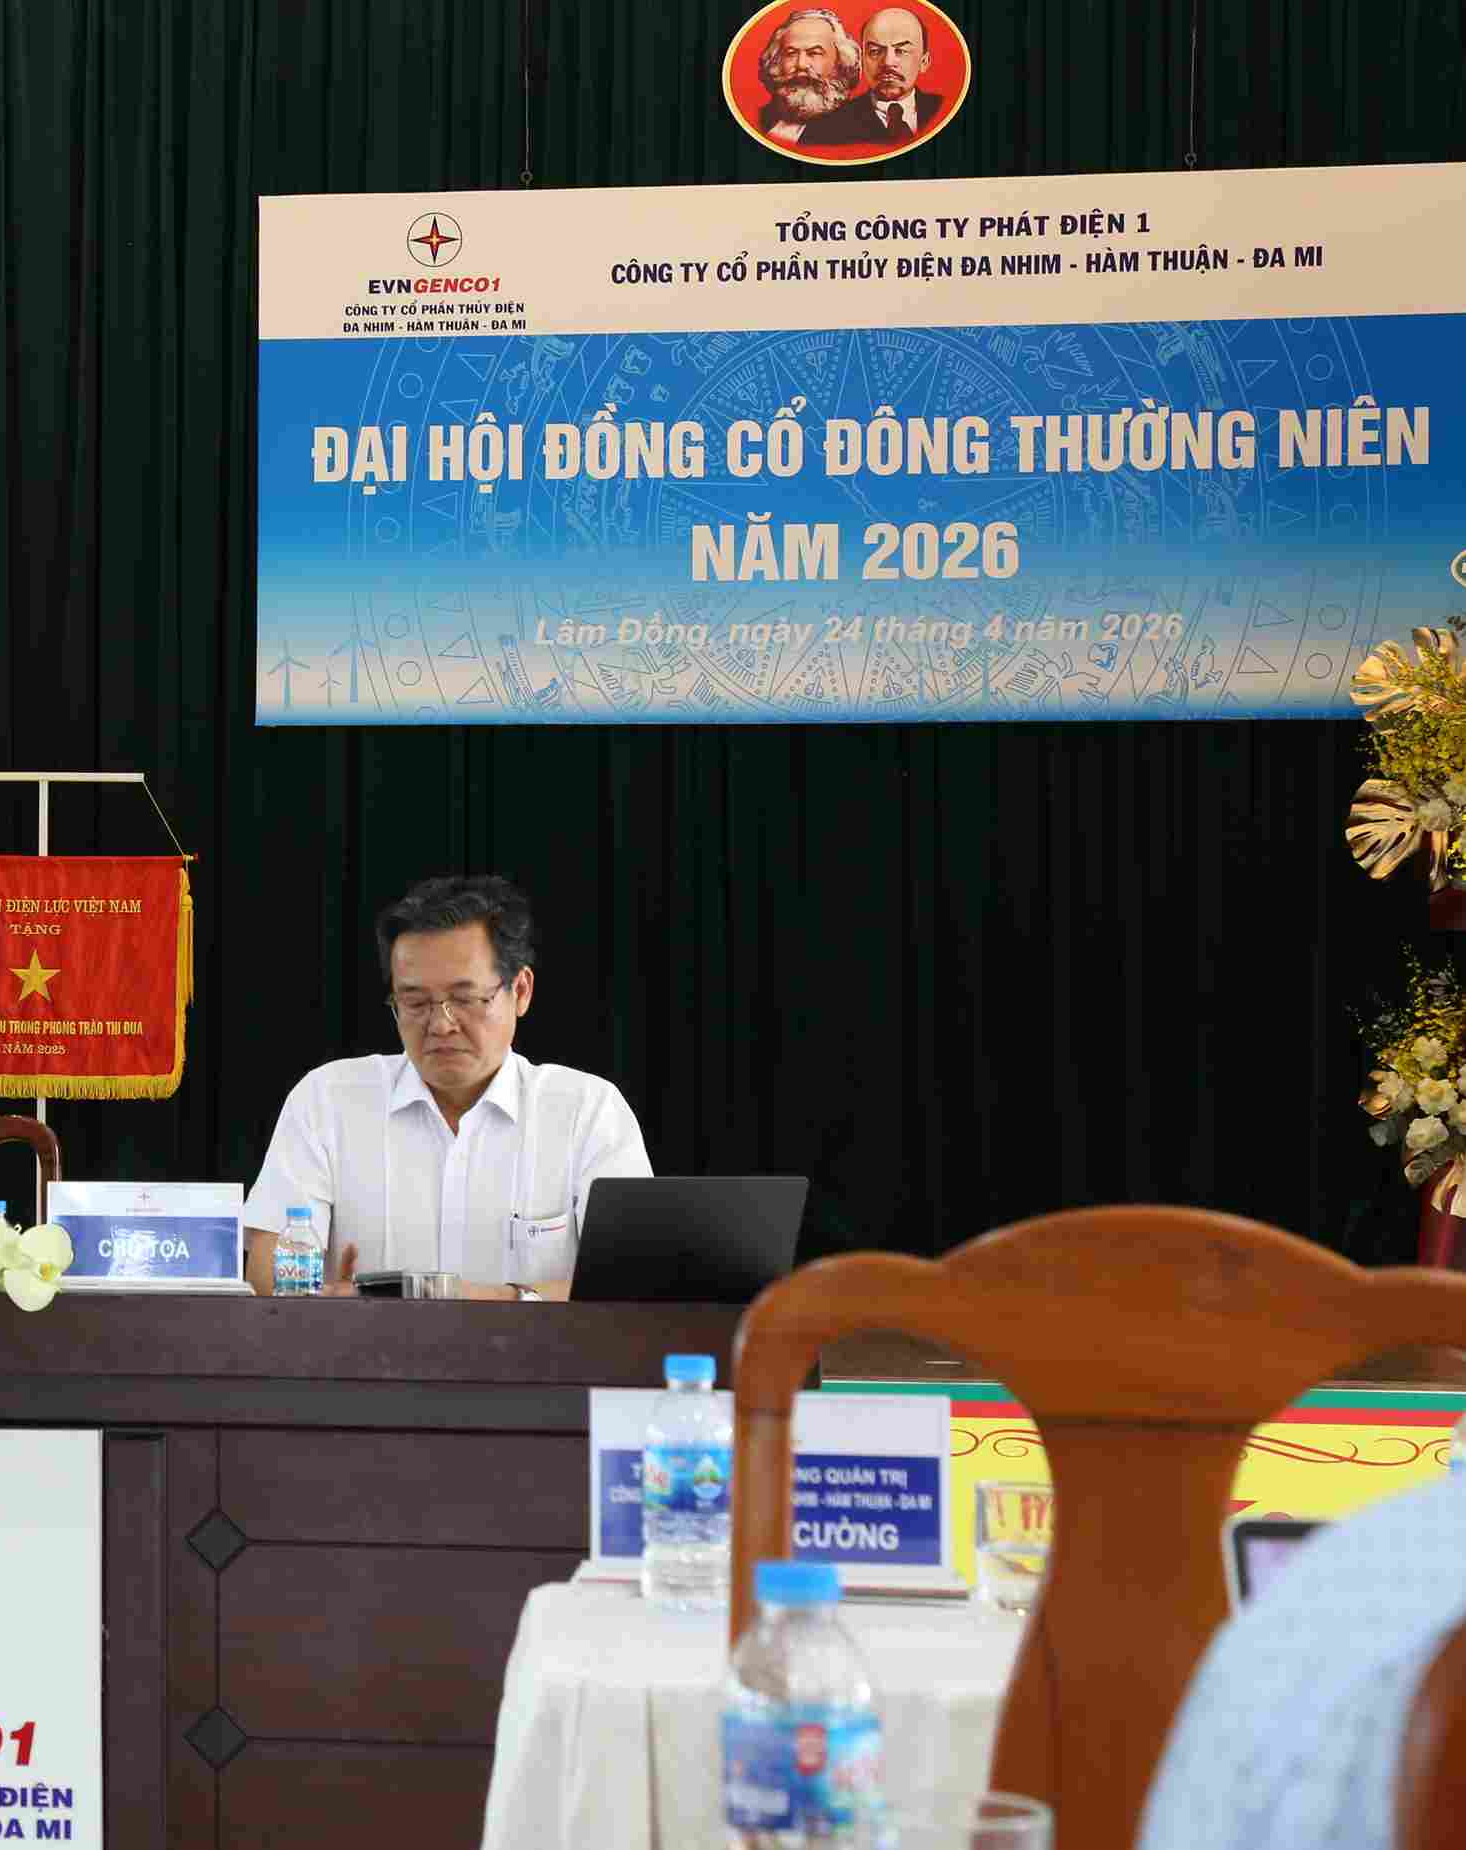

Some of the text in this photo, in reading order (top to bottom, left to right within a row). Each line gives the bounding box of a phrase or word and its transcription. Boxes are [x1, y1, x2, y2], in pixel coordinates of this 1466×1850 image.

[775, 208, 1150, 242] TỔNG CÔNG TY PHÁT ĐIỆN 1
[611, 244, 1323, 284] CÔNG TY CỔ PHẦN THỦY ĐIỆN ĐA NHIM HÀM THUẬN ĐA MI
[368, 277, 501, 294] EVNGENCO1
[345, 298, 524, 316] CÔNG TY CỔ PHẦN THỦY ĐIỆN
[343, 318, 526, 333] ĐA NHIM HÀM THUẬN ĐA MI
[312, 395, 1431, 495] ĐẠI HỘI ĐỒNG CỔ ĐÔNG THƯỜNG NIÊN
[691, 511, 1019, 581] NĂM 2026
[537, 618, 607, 642] Lâm
[730, 616, 814, 654] ngày
[823, 614, 864, 642] 24
[872, 614, 973, 649] tháng
[983, 611, 1007, 641] 4
[1014, 614, 1090, 641] năm
[1101, 611, 1185, 641] 2026
[6, 895, 40, 916] ĐIỆN
[44, 897, 70, 916] LỰC
[73, 895, 105, 917] VIỆT
[109, 899, 142, 913] NAM
[10, 922, 63, 936] TẶNG
[9, 1020, 42, 1035] TRONG
[43, 1020, 76, 1035] PHONG
[78, 1017, 103, 1036] TRÀO
[106, 1020, 121, 1035] THI
[123, 1020, 143, 1035] ĐUA
[2, 1043, 67, 1055] NĂM 2025
[793, 1515, 899, 1551] CƯỜNG
[36, 1818, 72, 1841] MI
